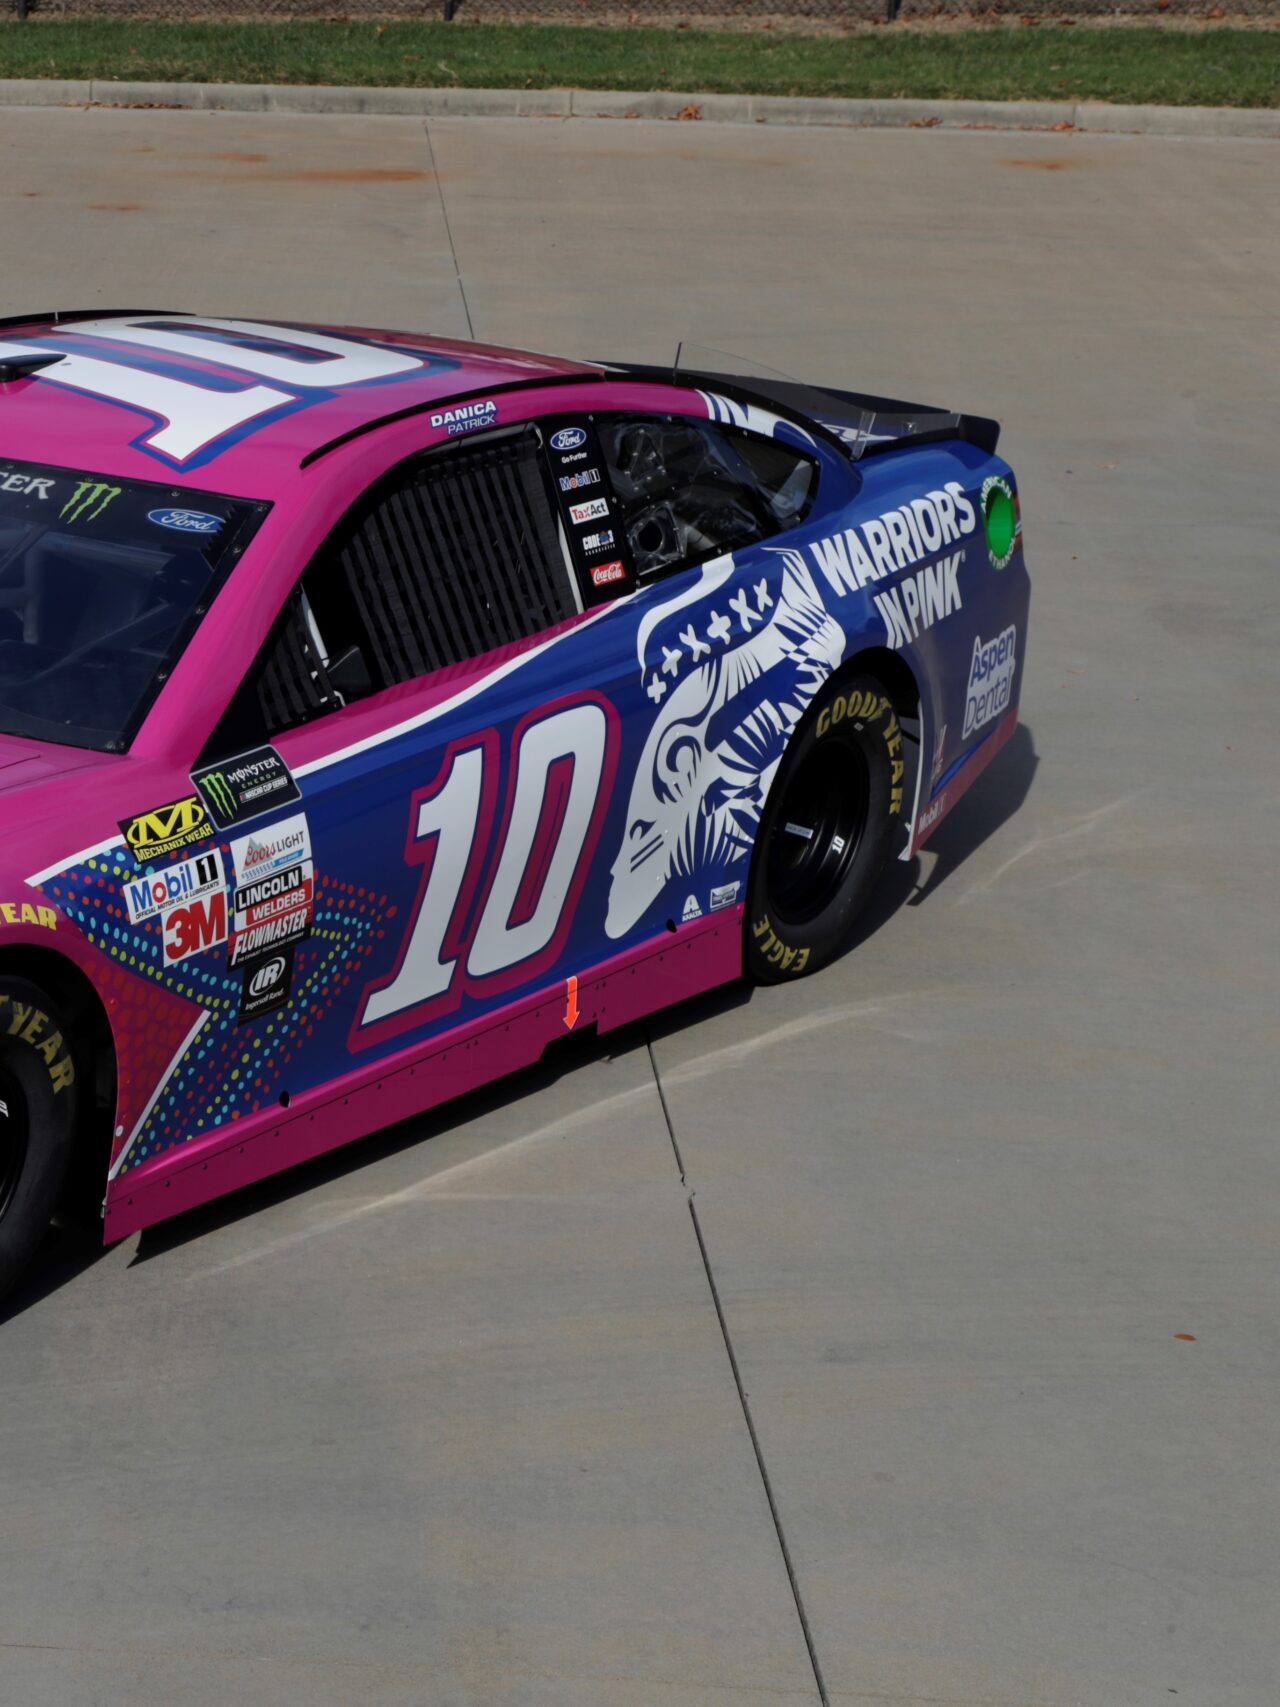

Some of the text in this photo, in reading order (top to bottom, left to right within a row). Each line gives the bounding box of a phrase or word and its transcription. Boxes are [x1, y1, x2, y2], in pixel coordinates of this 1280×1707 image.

[430, 400, 497, 428] DANICA
[447, 413, 496, 435] PATRICK
[558, 430, 581, 447] Ford
[559, 470, 591, 491] Mobil
[980, 475, 1013, 513] AMERICAN
[160, 511, 216, 530] Ford
[571, 502, 607, 521] TaxAct
[809, 481, 976, 598] WARRIORS
[873, 550, 963, 650] IN PINK
[969, 629, 1015, 688] Aspen
[964, 665, 1012, 733] Dental
[815, 690, 905, 815] GOODYEAR
[134, 822, 215, 863] MECHANIX WEAR
[244, 843, 277, 867] Coors
[276, 830, 305, 853] LIGHT
[360, 703, 607, 1027] 10
[130, 863, 194, 913] Mobil
[237, 870, 300, 910] LINCOLN
[252, 890, 306, 921] WELDERS
[135, 906, 156, 920] OFFICIAL
[157, 898, 176, 911] MOTOR
[165, 891, 226, 960] 3M
[230, 907, 308, 967] FLOWMASTER
[752, 914, 811, 972] EAGLE
[254, 963, 280, 992] IR
